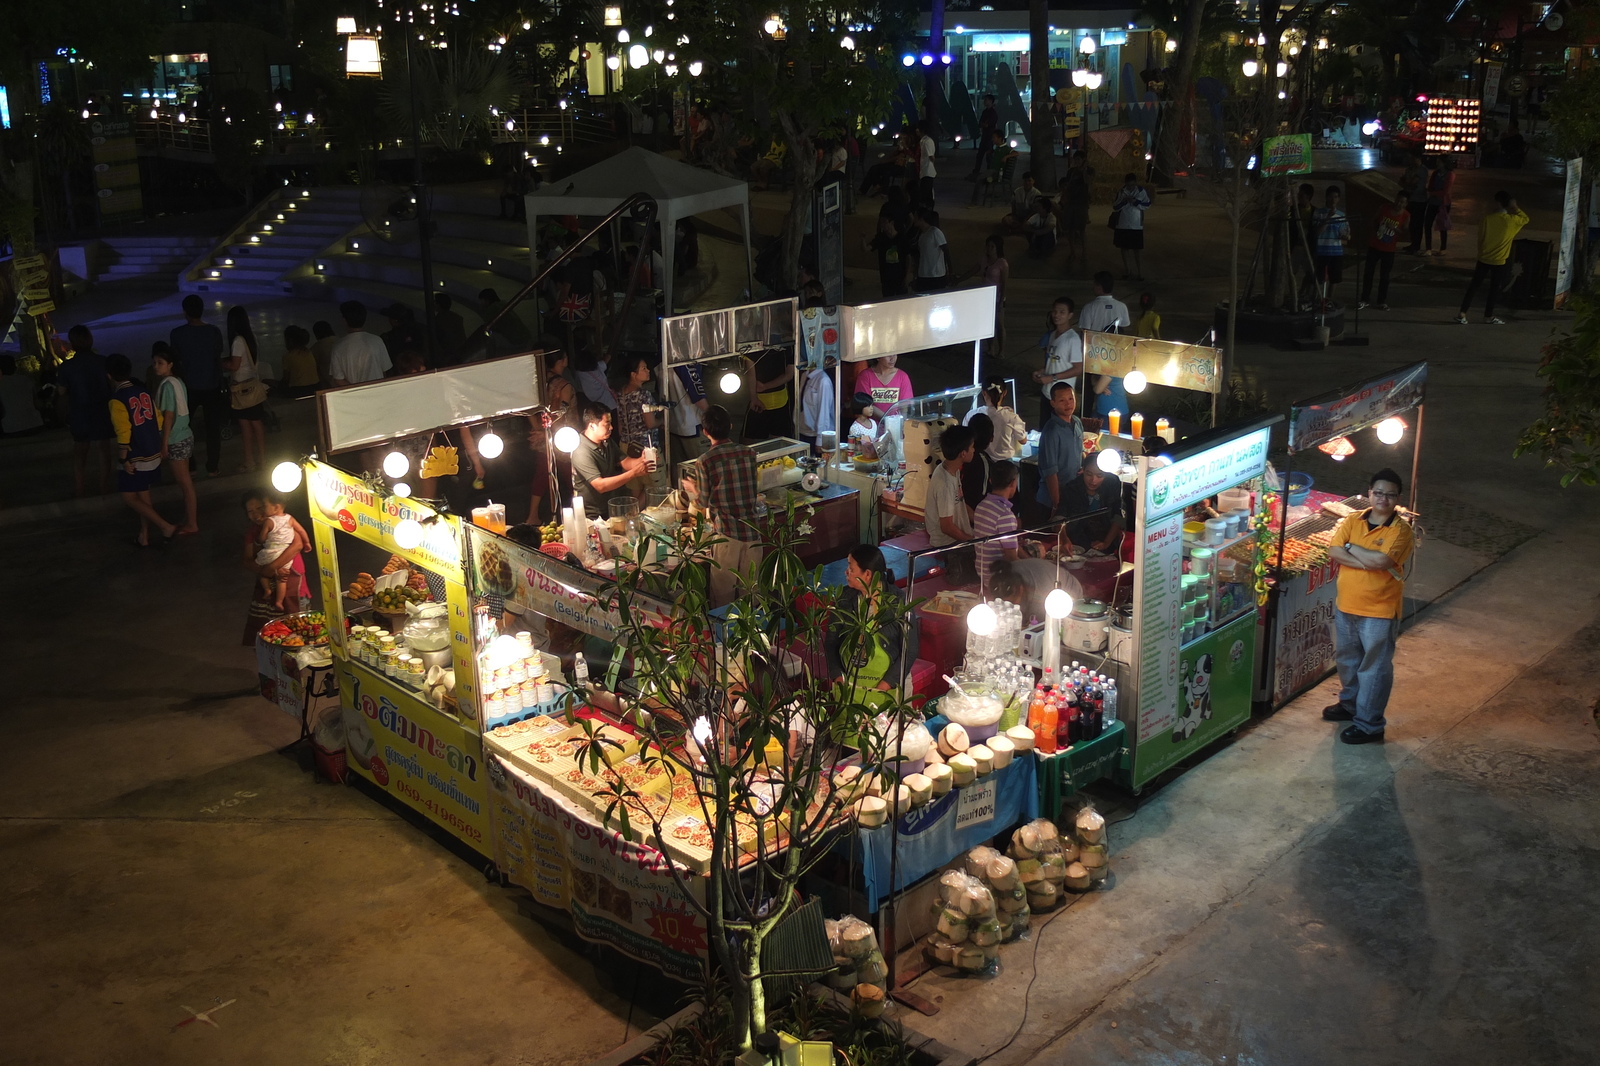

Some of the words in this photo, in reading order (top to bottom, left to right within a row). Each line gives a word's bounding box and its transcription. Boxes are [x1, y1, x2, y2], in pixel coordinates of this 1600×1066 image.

[129, 392, 154, 427] 29
[1148, 527, 1168, 545] MENU
[554, 599, 599, 630] (Belgium
[342, 670, 480, 782] ไอติมกะลา
[371, 760, 388, 780] 25-30
[396, 779, 483, 844] 089-4196562
[655, 913, 680, 939] 10
